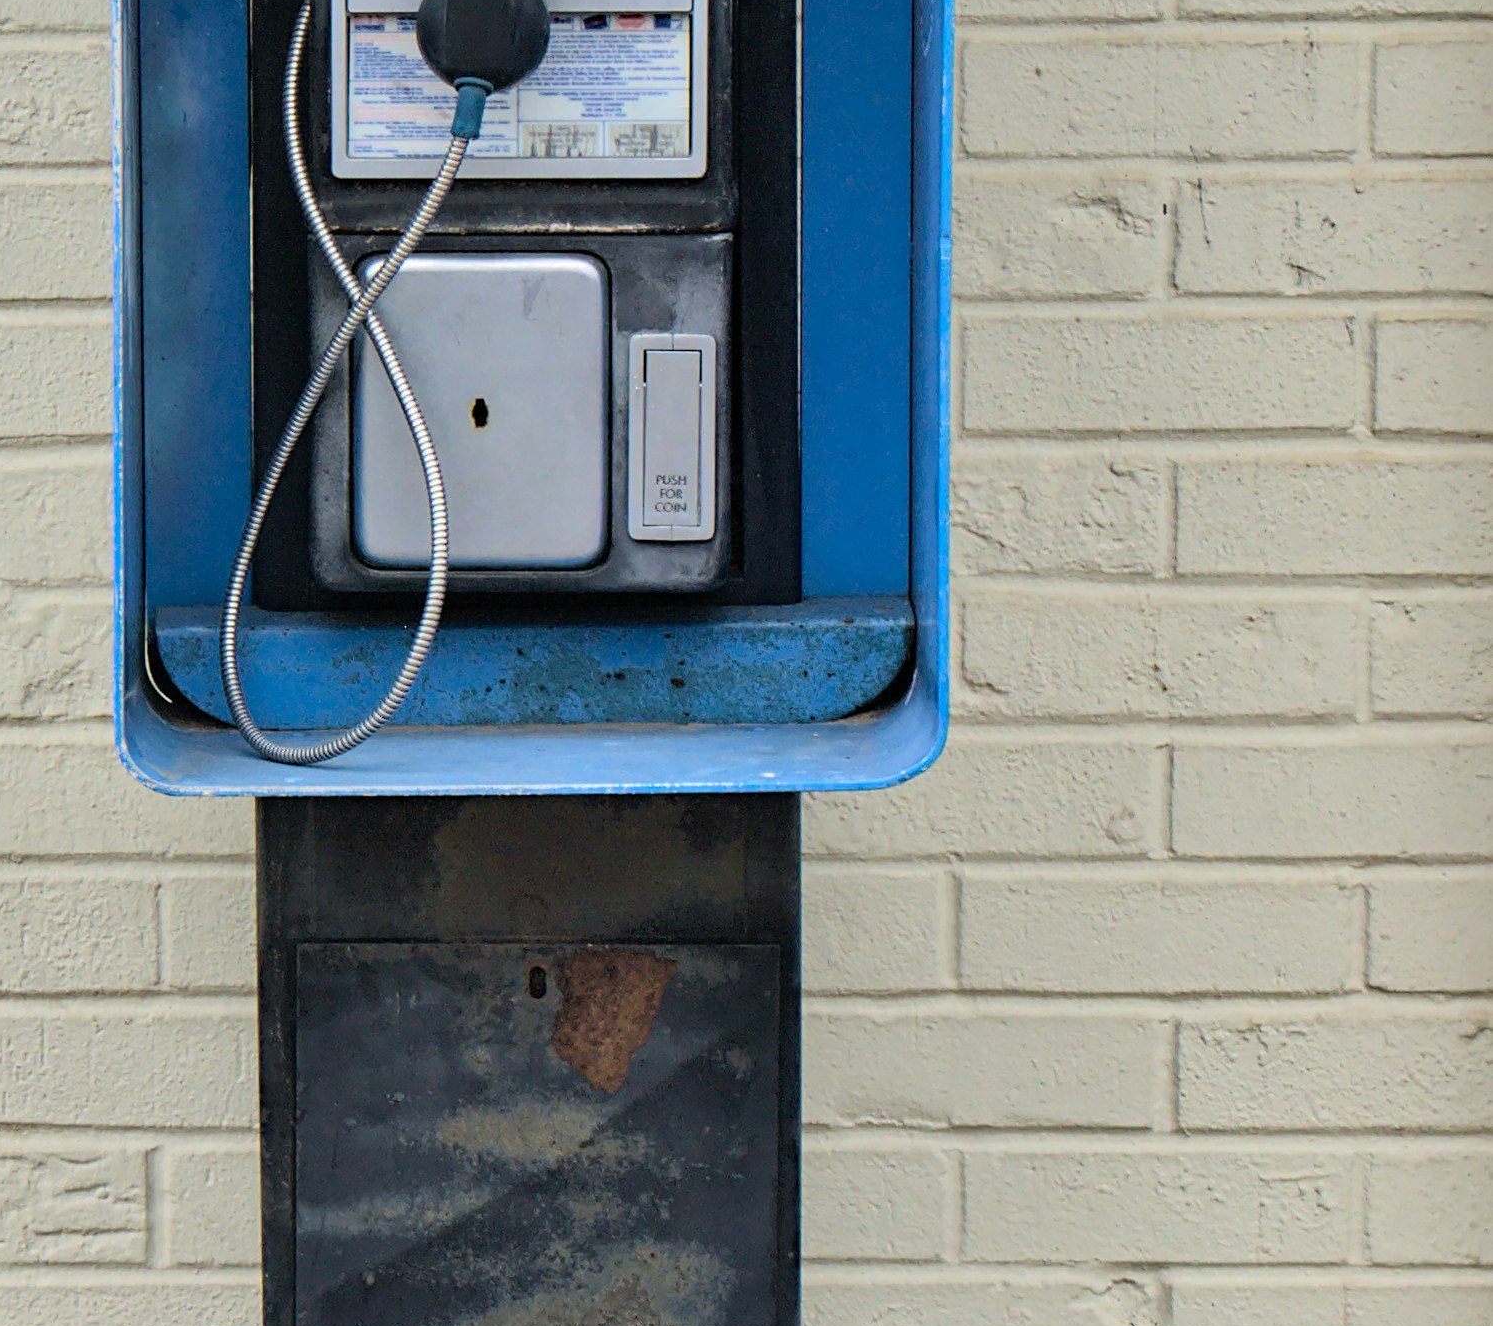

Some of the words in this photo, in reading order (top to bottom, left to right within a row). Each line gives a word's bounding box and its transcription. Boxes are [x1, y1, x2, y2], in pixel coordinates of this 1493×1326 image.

[656, 475, 687, 485] PUSH
[660, 489, 683, 499] FOR
[655, 502, 686, 512] COIN
